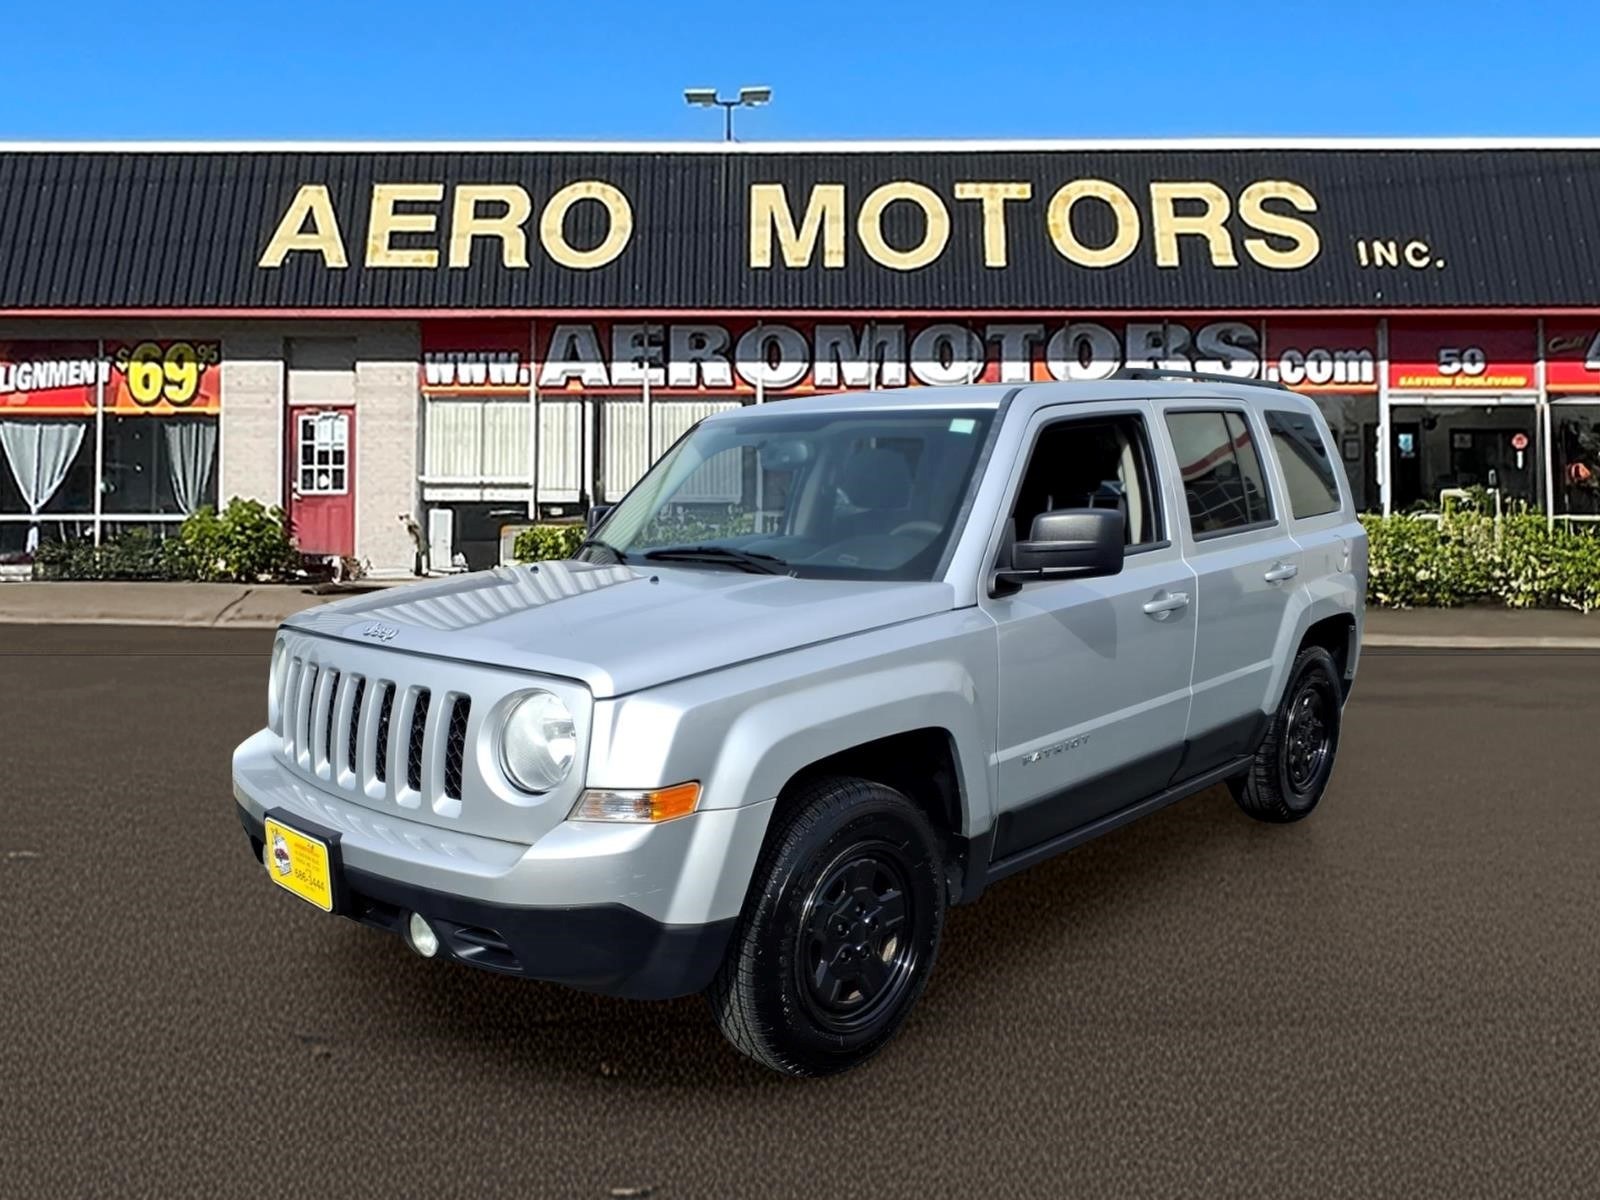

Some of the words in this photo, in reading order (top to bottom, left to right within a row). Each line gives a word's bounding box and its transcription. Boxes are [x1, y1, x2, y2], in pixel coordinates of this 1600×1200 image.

[258, 180, 633, 270] AERO
[749, 180, 1321, 270] MOTORS
[1357, 240, 1445, 268] INC.
[1438, 348, 1486, 375] 50
[1400, 376, 1453, 387] EASTERN
[1454, 376, 1527, 387] BOULEVARD
[363, 622, 400, 641] Jeep
[1022, 733, 1090, 767] PATRIOT
